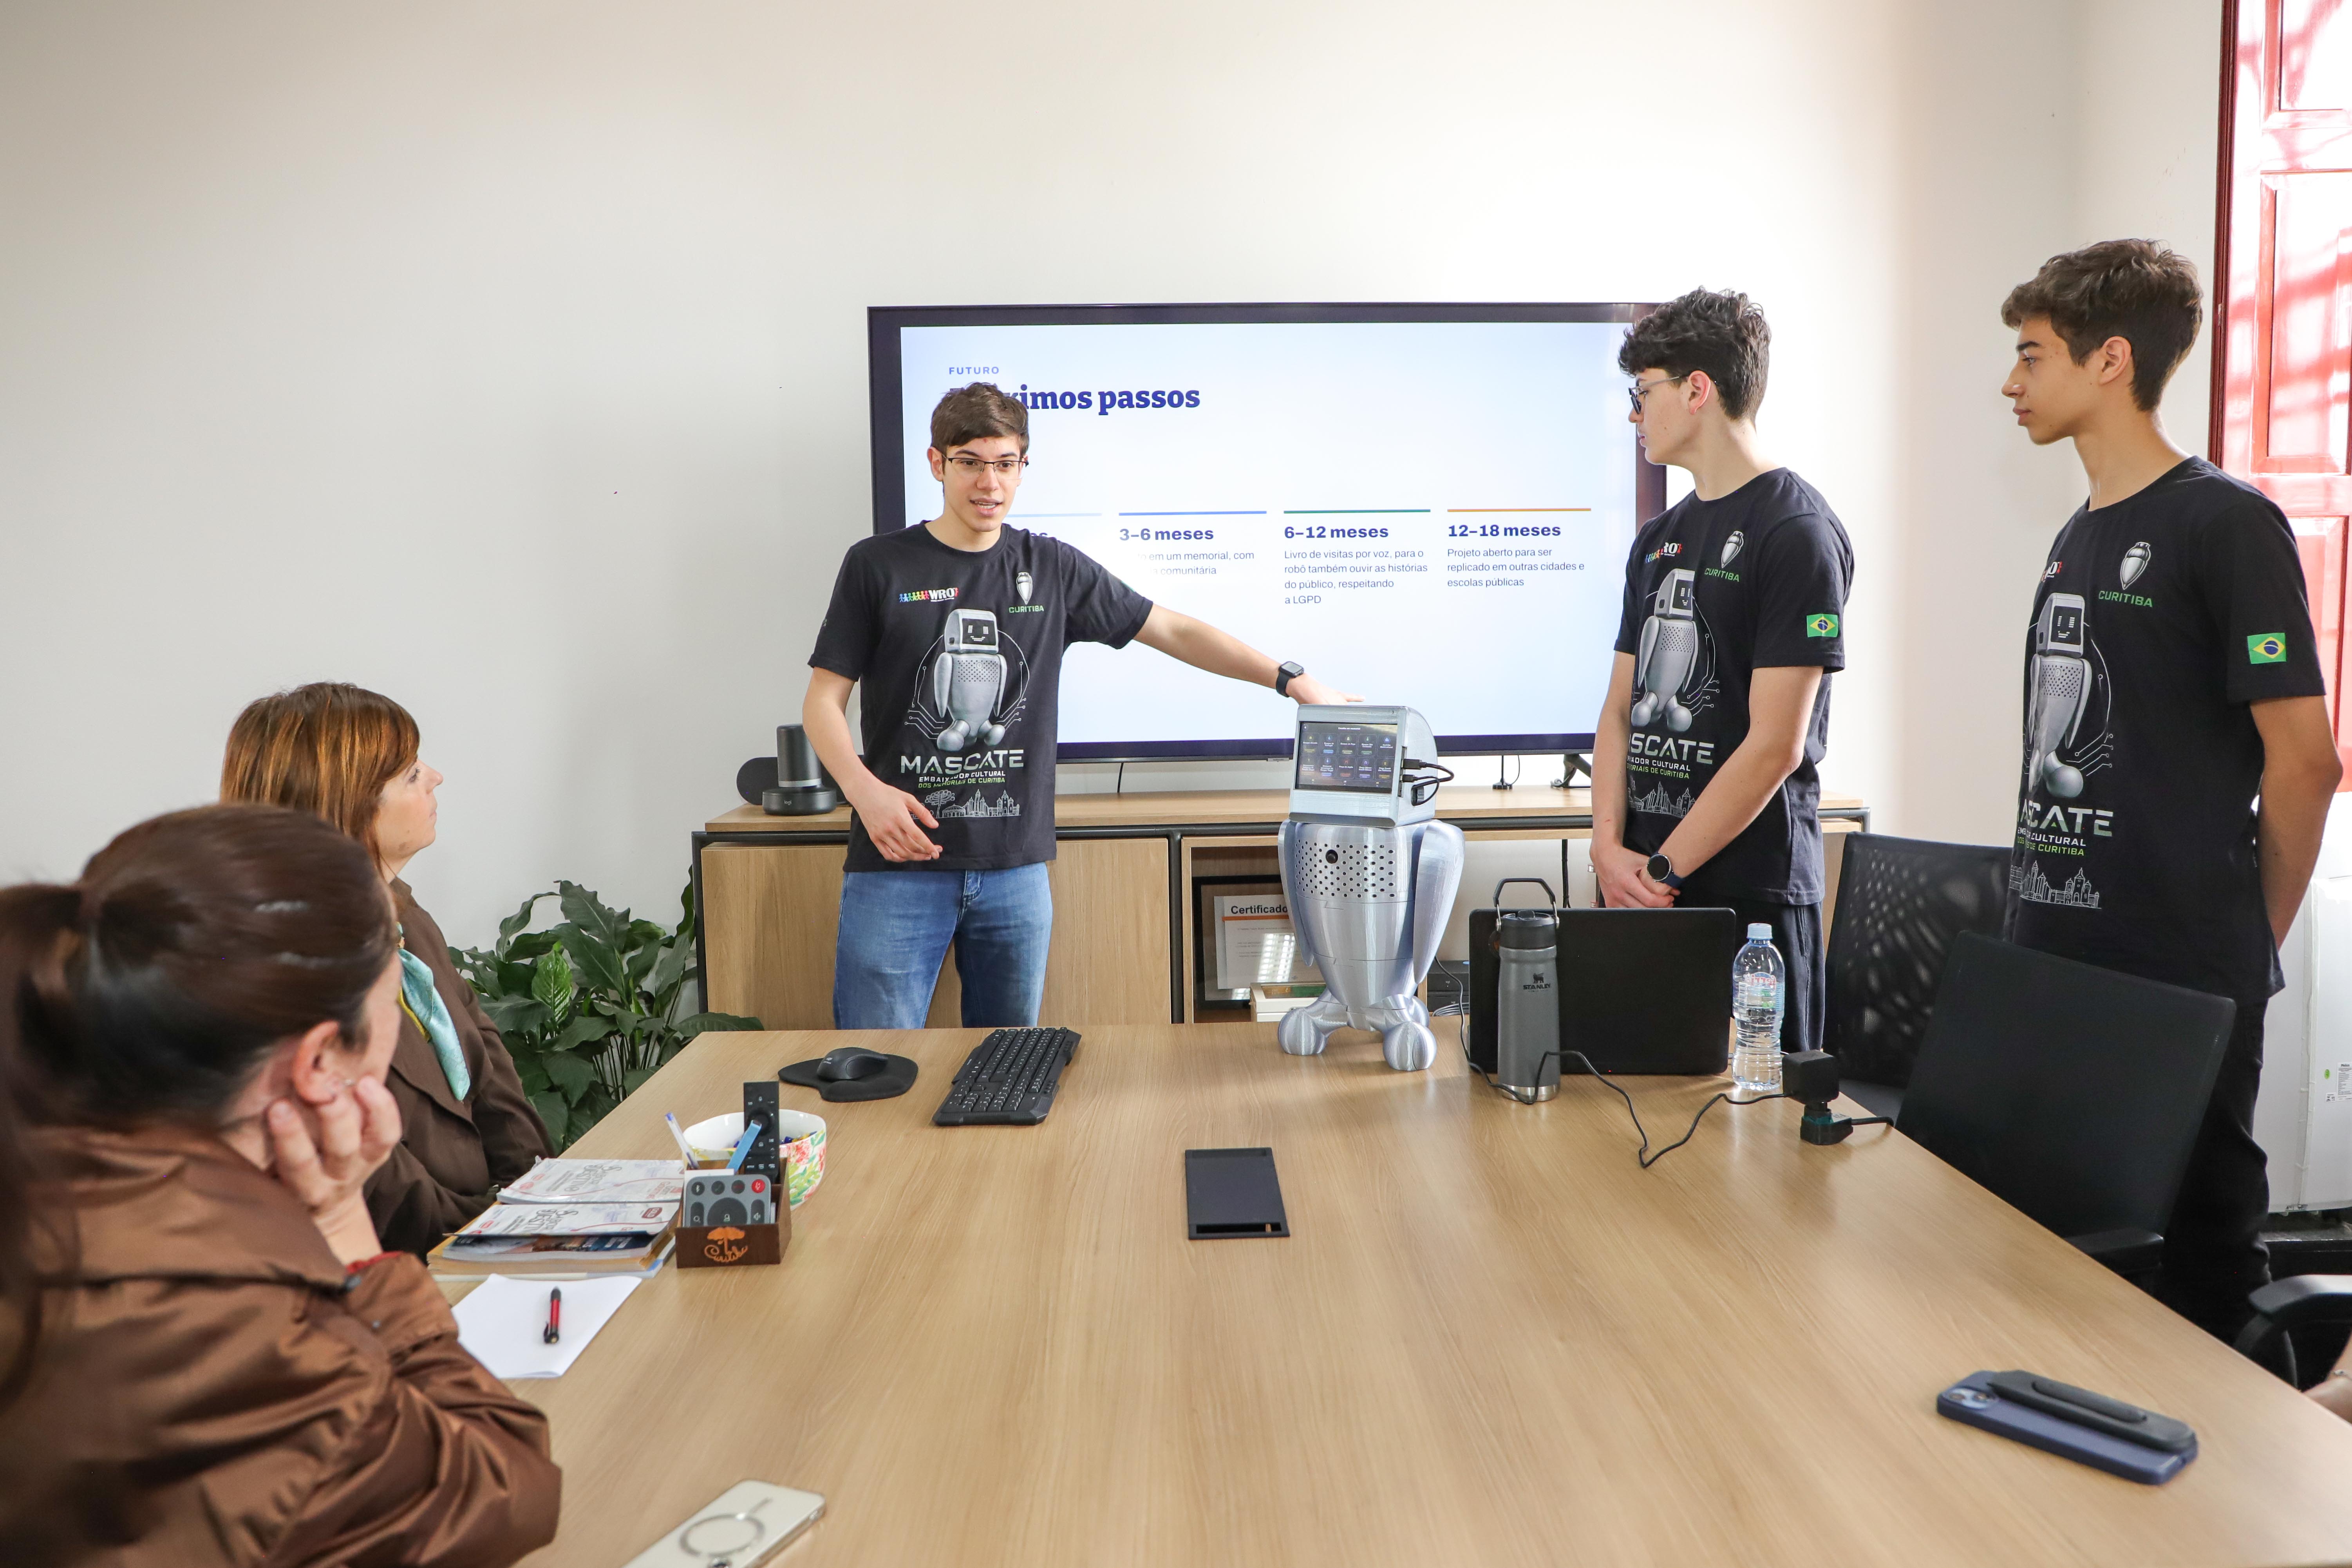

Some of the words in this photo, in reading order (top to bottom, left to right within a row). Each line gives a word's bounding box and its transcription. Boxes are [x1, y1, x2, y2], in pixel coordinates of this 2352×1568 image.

[949, 366, 999, 375] FUTURO
[1098, 389, 1200, 415] passos
[1155, 530, 1214, 540] meses
[1331, 528, 1388, 538] meses
[1504, 526, 1561, 537] meses
[1184, 551, 1231, 561] memorial,
[1309, 550, 1321, 558] de
[1323, 550, 1353, 558] visitas
[1356, 551, 1371, 559] por
[1395, 550, 1416, 559] para
[1448, 548, 1481, 559] Projeto
[1483, 548, 1513, 557] aberto
[1515, 549, 1535, 558] para
[1161, 566, 1217, 575] comunitária
[1284, 564, 1306, 573] robô
[1308, 564, 1347, 573] também
[1349, 564, 1372, 572] ouvir
[1388, 563, 1428, 572] histórias
[1448, 563, 1490, 573] replicado
[1540, 562, 1576, 570] cidades
[1704, 568, 1739, 582] CURITIBA
[1284, 580, 1296, 589] do
[1299, 579, 1336, 590] público,
[1338, 579, 1394, 590] respeitando
[1448, 578, 1483, 587] escolas
[1486, 578, 1524, 588] públicas
[928, 588, 955, 600] WRO
[1293, 595, 1322, 604] LGPD
[2098, 590, 2153, 607] CURITIBA
[1009, 604, 1045, 614] CURITIBA
[1629, 732, 1714, 765] SCATE
[900, 749, 1024, 774] MASCATE
[1652, 760, 1691, 771] CULTURAL
[1660, 769, 1690, 779] CURITIBA
[2031, 833, 2086, 846] CULTURAL
[2038, 844, 2084, 856] CURITIBA
[1231, 904, 1288, 914] Certificado
